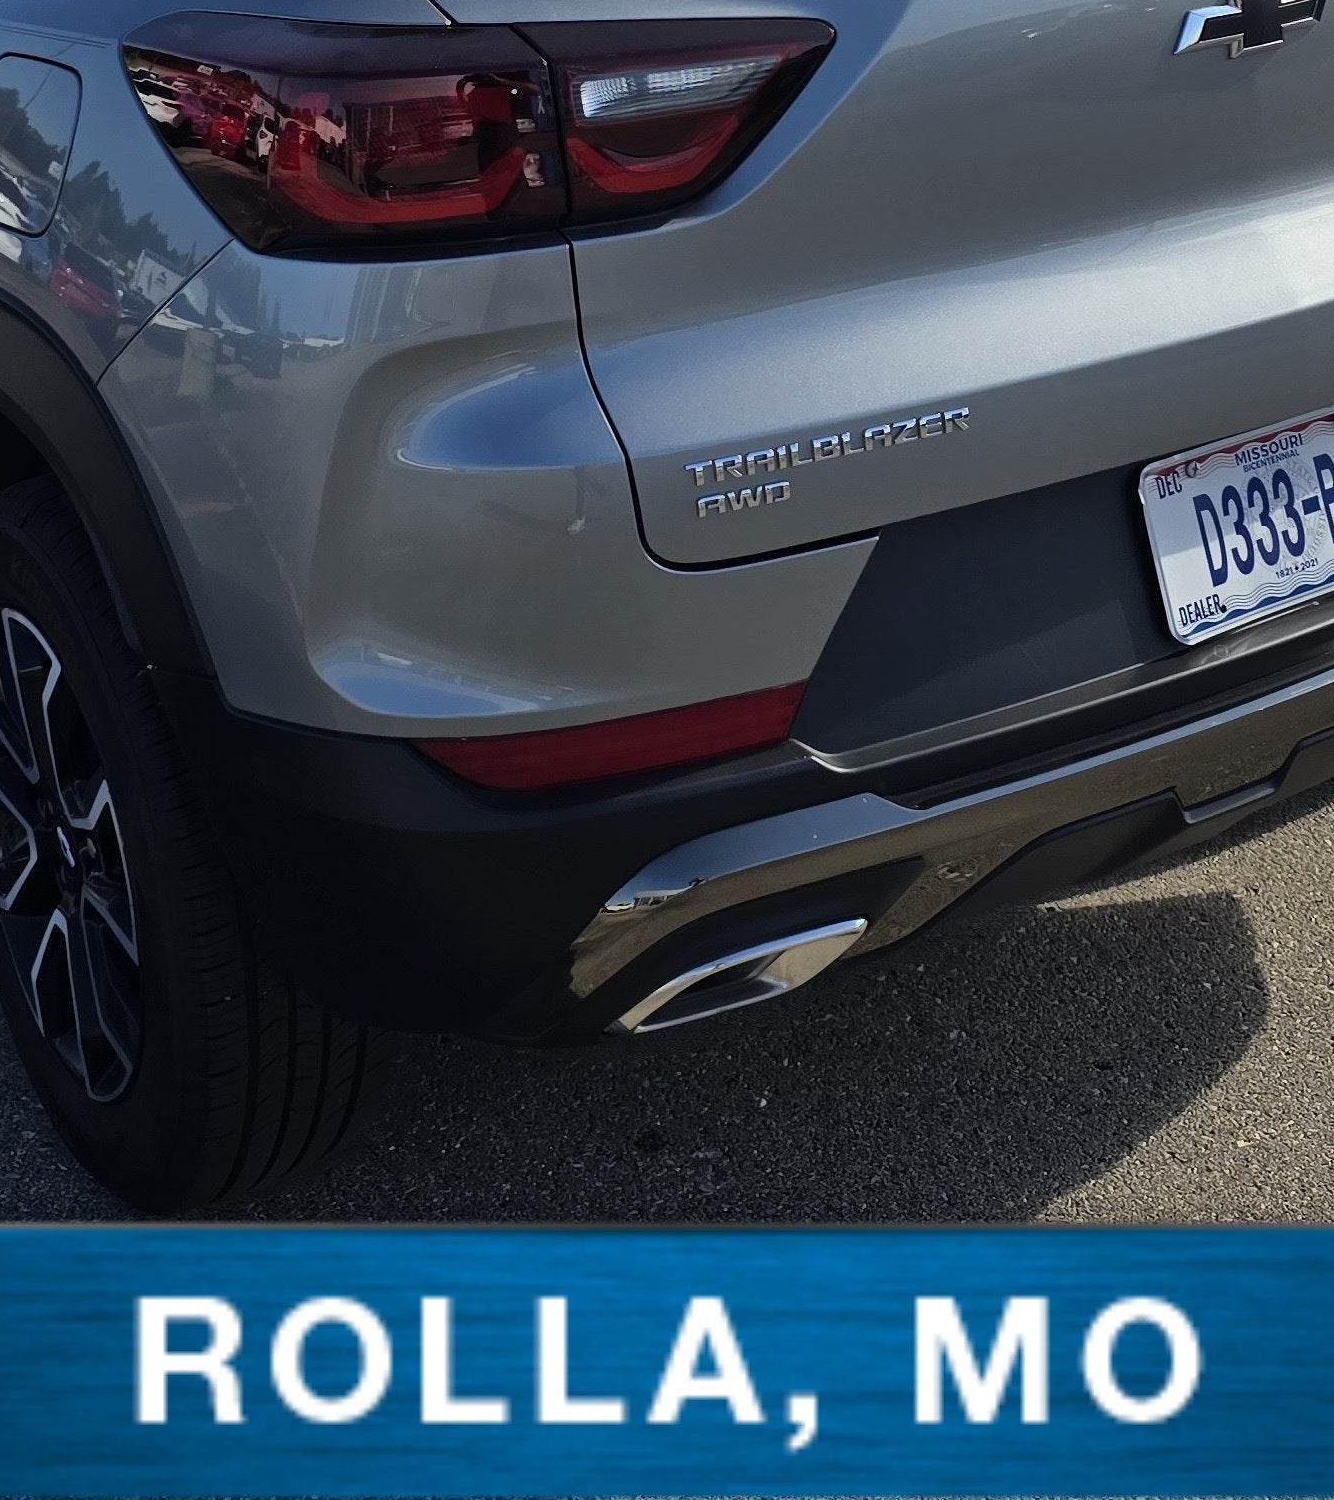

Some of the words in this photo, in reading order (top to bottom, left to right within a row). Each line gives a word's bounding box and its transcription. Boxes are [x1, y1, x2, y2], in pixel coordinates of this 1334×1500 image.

[684, 407, 970, 487] TRAILBLAZER
[1242, 449, 1301, 474] BICENTENNIAL
[1154, 470, 1184, 500] DEC
[1233, 432, 1305, 467] MISSOURI
[696, 480, 792, 519] AWD
[1275, 564, 1295, 580] 1821
[1300, 557, 1320, 573] 2021
[1177, 593, 1223, 628] DEALER
